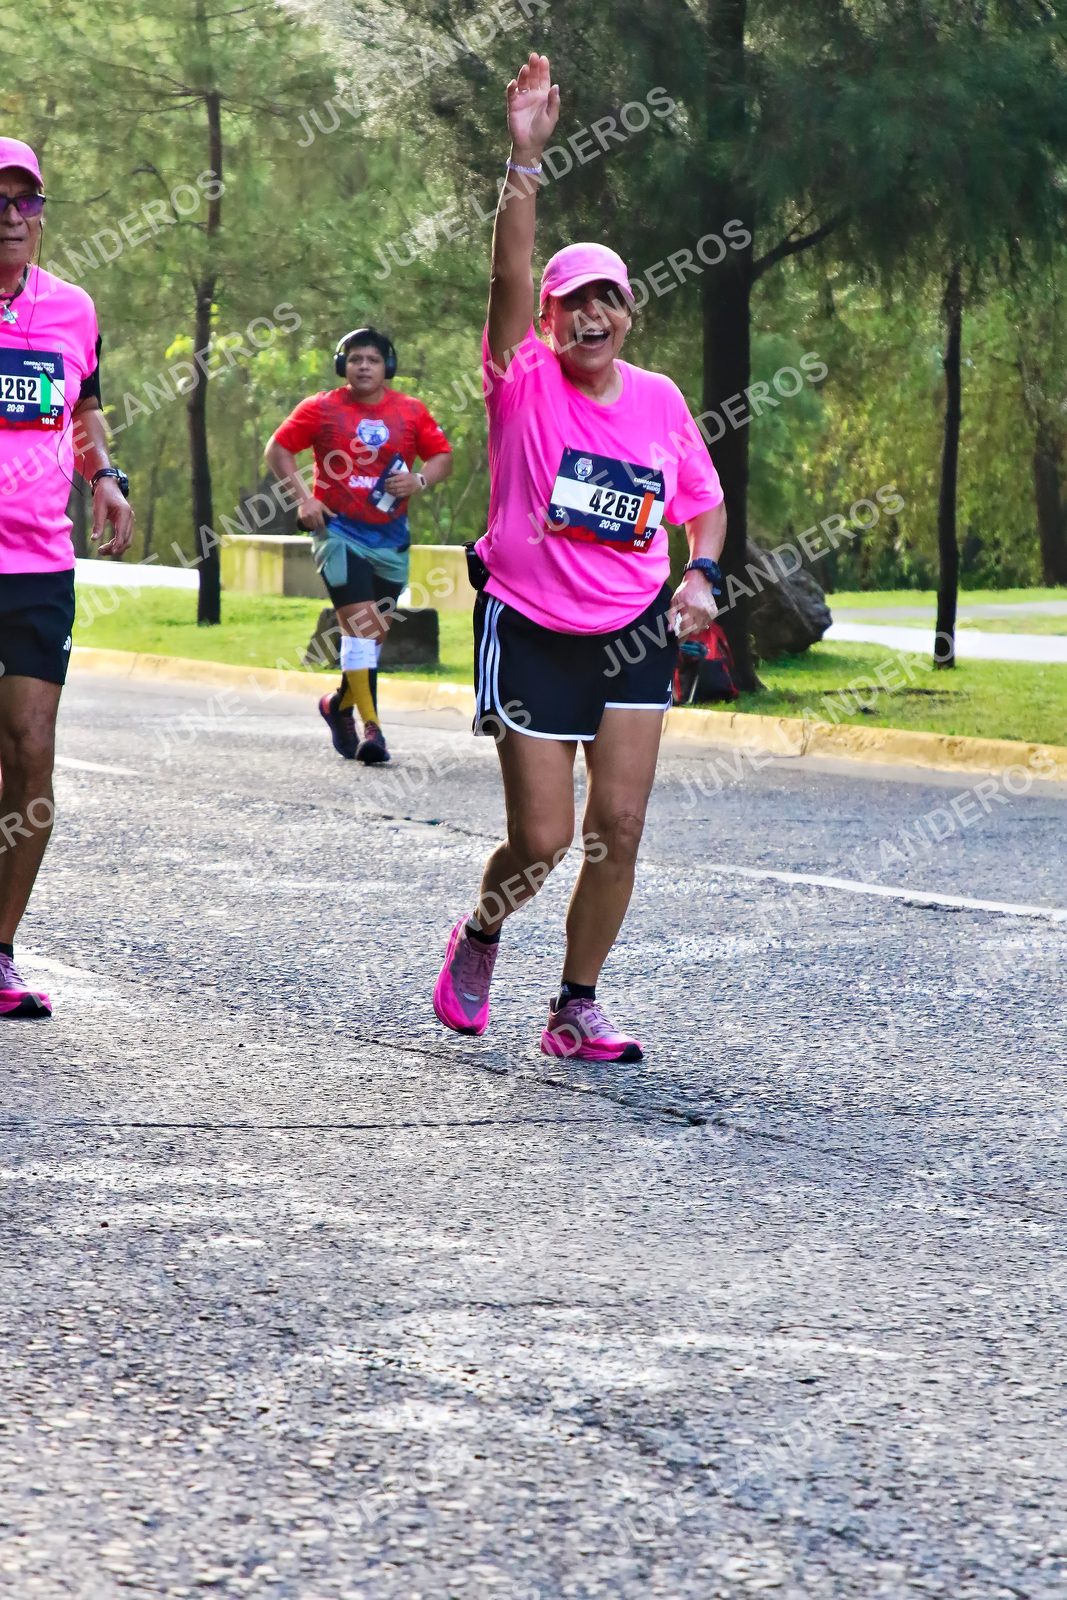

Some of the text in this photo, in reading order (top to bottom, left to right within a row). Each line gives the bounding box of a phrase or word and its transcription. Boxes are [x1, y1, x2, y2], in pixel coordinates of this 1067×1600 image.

[41, 417, 55, 425] 10K
[589, 489, 641, 522] 4263
[598, 519, 621, 532] 20-26
[633, 539, 646, 548] 10K
